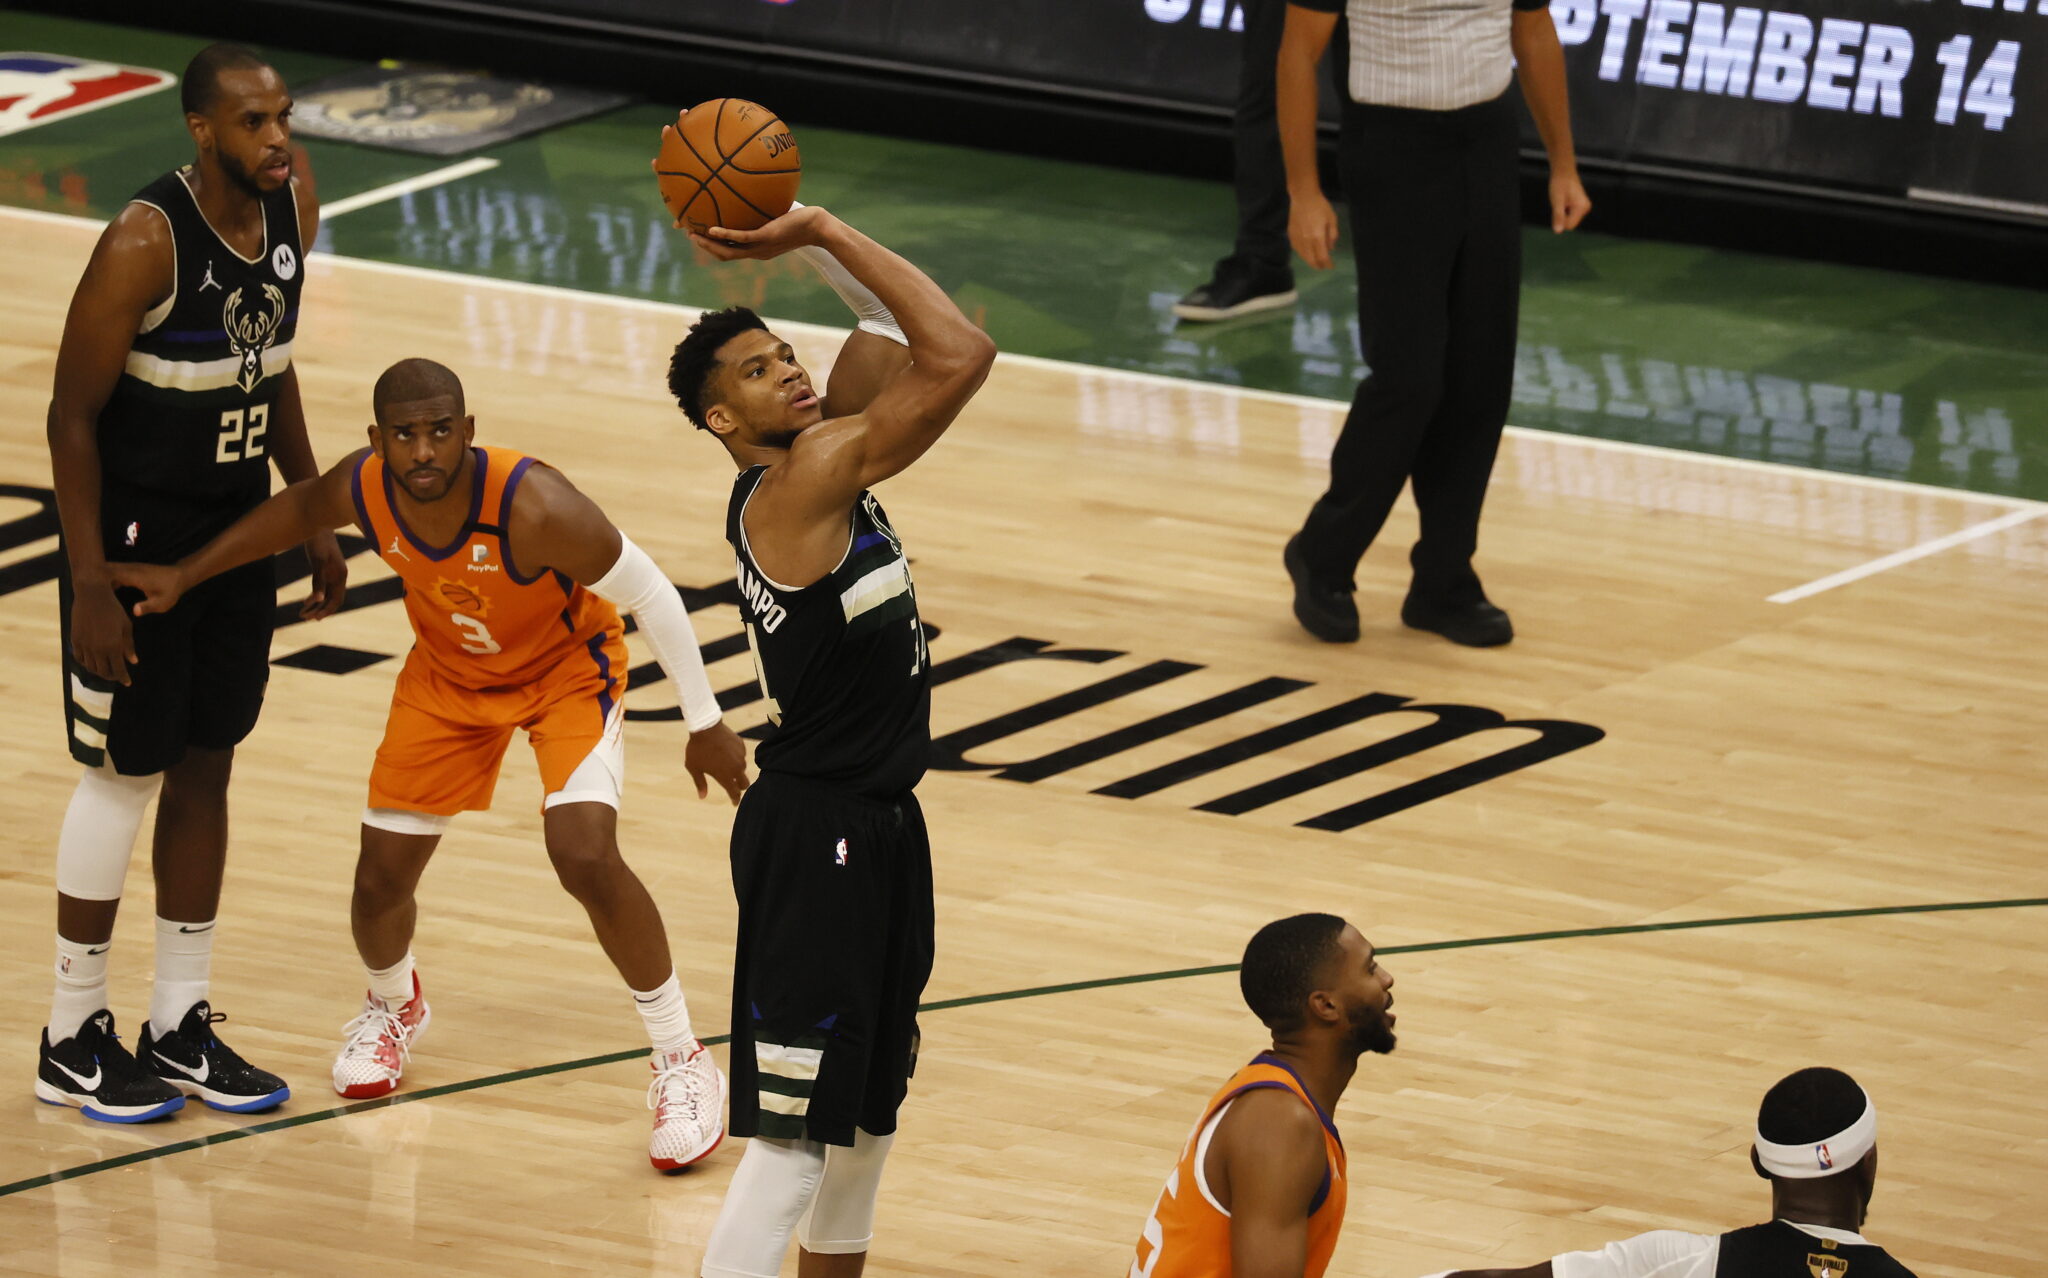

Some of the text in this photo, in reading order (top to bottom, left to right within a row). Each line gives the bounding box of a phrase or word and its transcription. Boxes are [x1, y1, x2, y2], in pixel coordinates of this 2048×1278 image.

[1934, 34, 2022, 132] 14
[216, 403, 269, 464] 22
[467, 563, 499, 573] PayPal
[451, 613, 501, 654] 3
